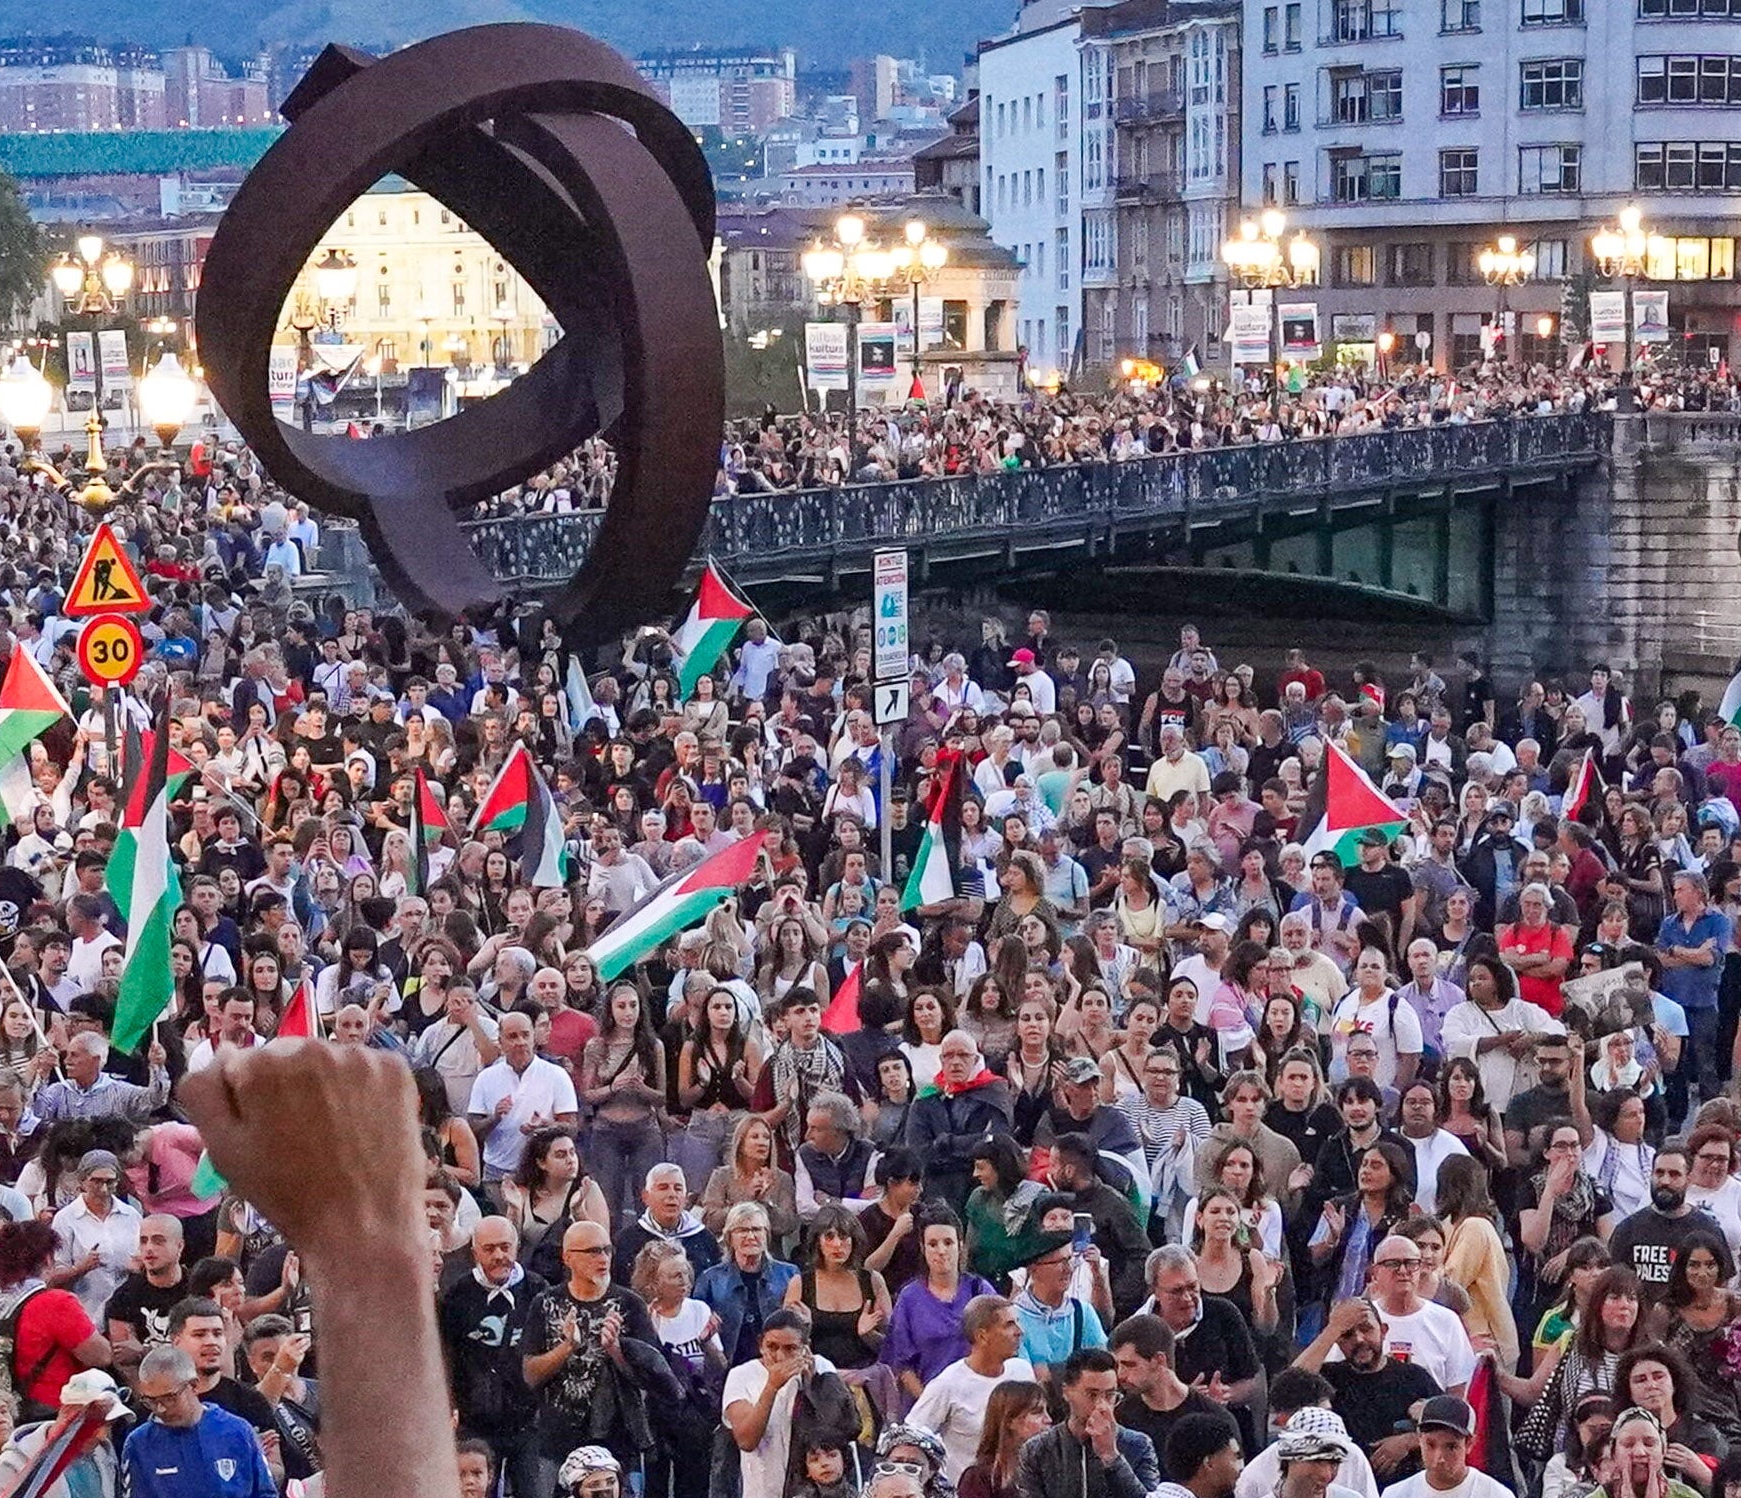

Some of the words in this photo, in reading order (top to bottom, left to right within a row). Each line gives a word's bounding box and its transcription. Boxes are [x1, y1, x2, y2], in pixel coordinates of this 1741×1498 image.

[93, 639, 128, 663] 30
[1632, 1245, 1668, 1263] FREE
[1634, 1263, 1670, 1283] PALES
